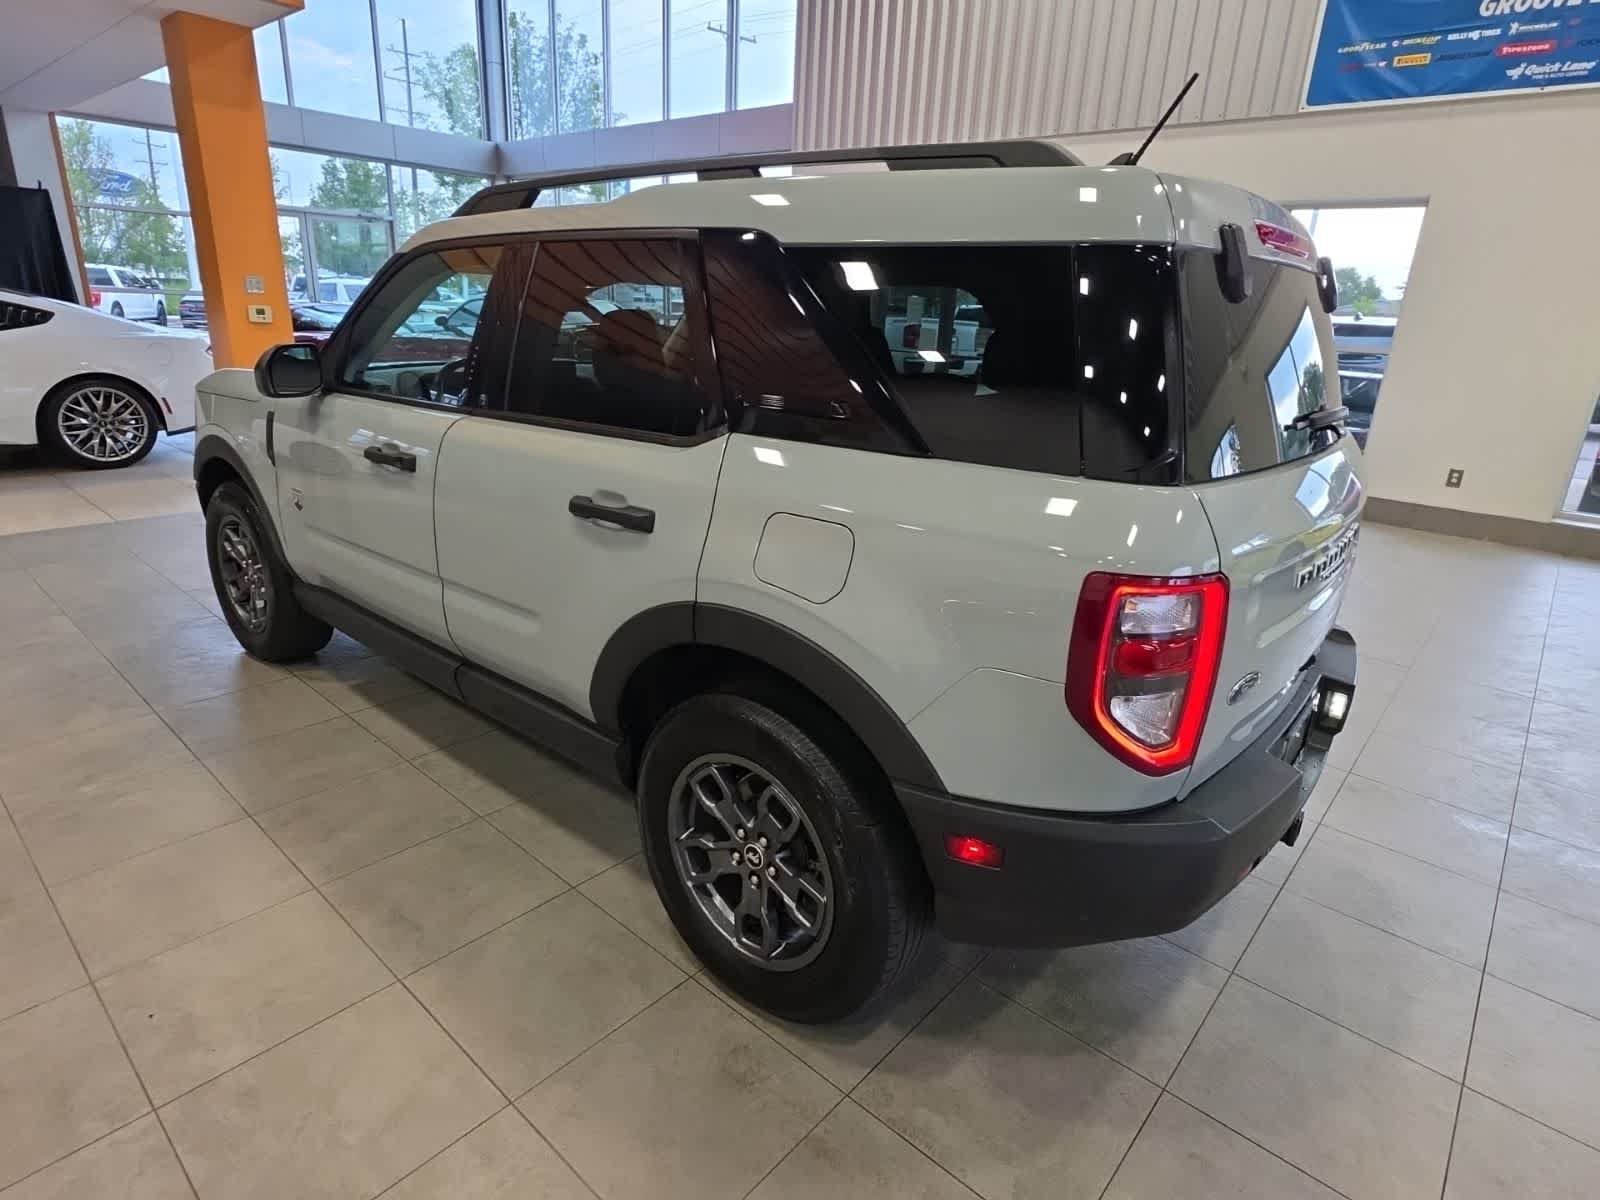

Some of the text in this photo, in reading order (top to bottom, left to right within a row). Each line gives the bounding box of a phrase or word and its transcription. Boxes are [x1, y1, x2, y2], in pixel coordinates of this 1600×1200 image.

[1480, 0, 1581, 17] GROO
[1337, 42, 1387, 53] GOODYEAR
[1524, 60, 1597, 75] Quick Lane
